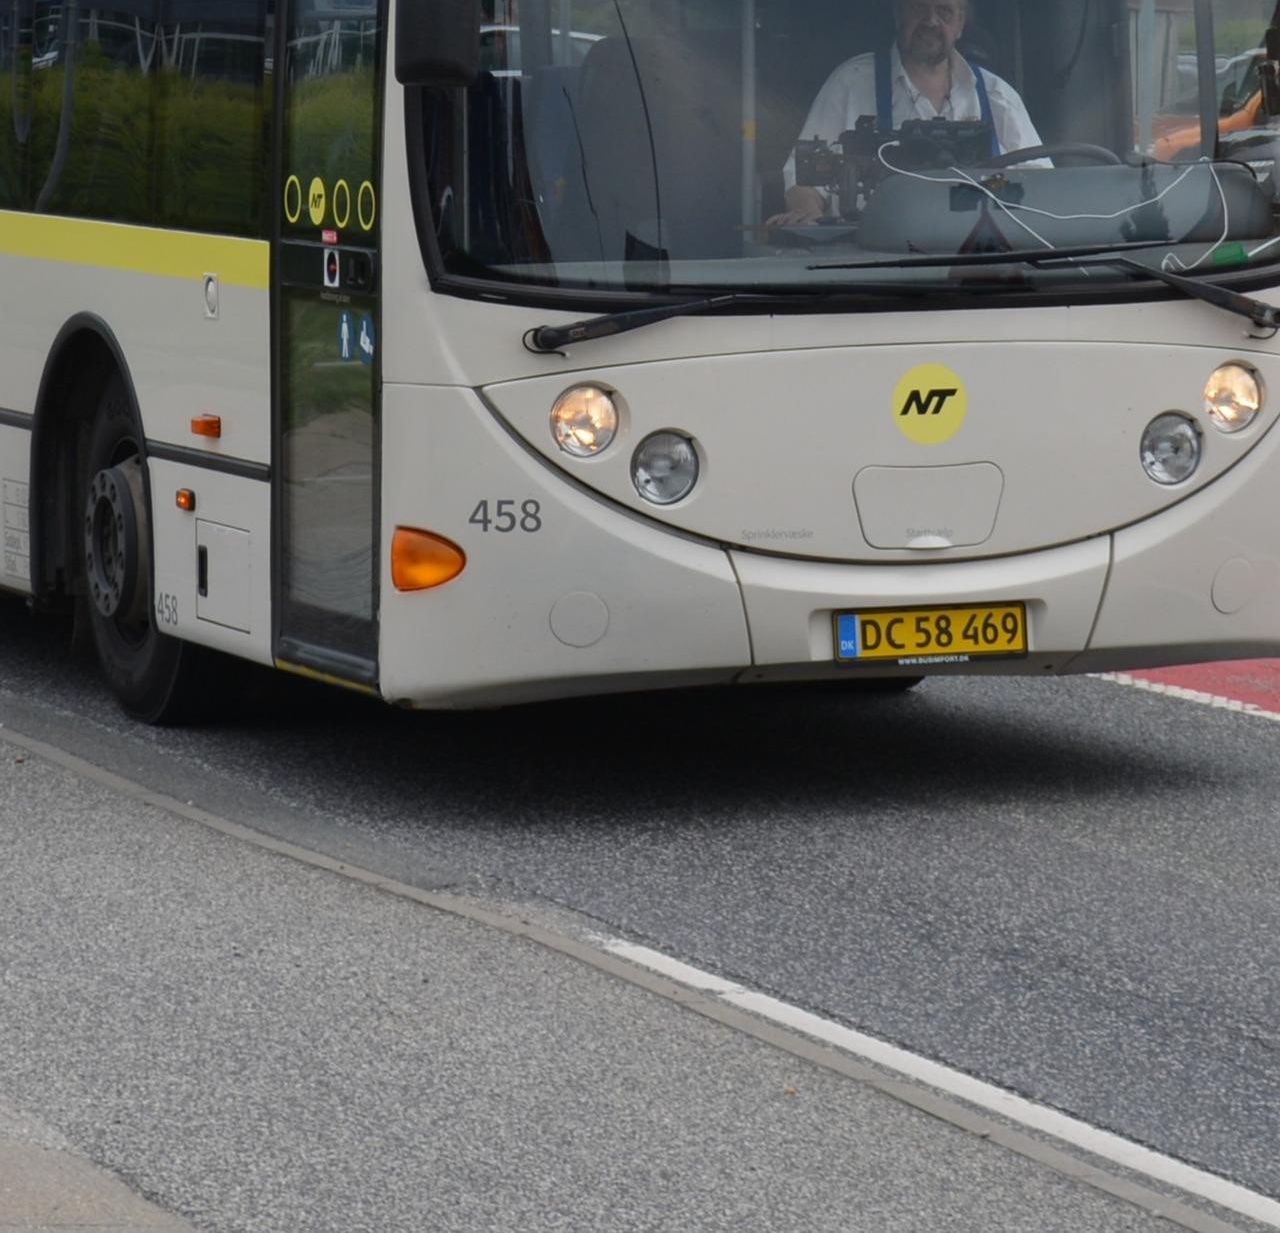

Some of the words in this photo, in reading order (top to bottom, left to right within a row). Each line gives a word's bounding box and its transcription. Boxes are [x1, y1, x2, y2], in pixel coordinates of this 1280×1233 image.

[311, 194, 324, 209] NT
[900, 388, 958, 416] NT
[468, 499, 542, 533] 458
[741, 528, 814, 541] Sprinklervæske
[157, 592, 179, 626] 458
[860, 617, 906, 651] DC
[914, 614, 954, 648] 58
[961, 611, 1019, 645] 469
[841, 640, 855, 651] DK
